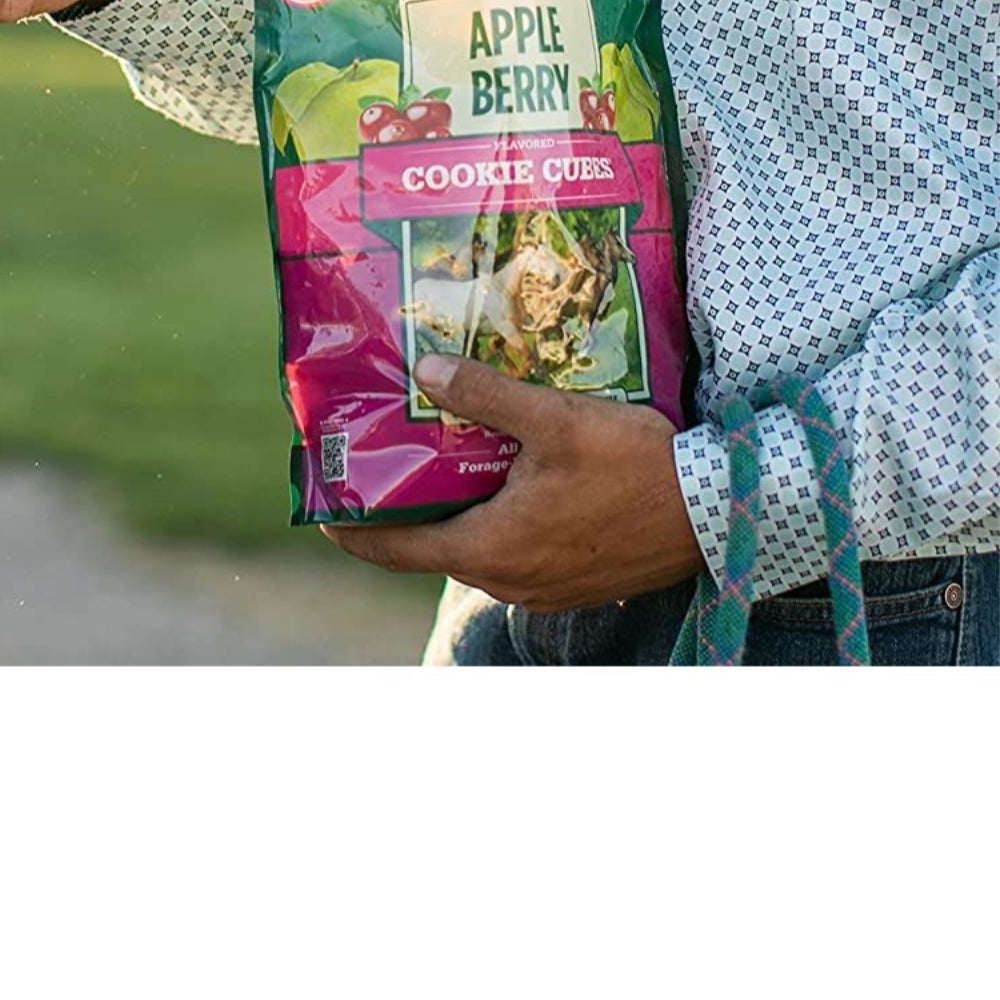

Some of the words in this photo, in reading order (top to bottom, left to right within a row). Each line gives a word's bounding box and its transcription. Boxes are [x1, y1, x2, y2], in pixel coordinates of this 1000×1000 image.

[470, 6, 565, 59] APPLE
[471, 63, 570, 117] BERRY
[494, 138, 555, 151] FLAVORED
[402, 159, 534, 192] COOKIE
[542, 156, 615, 183] CUBES
